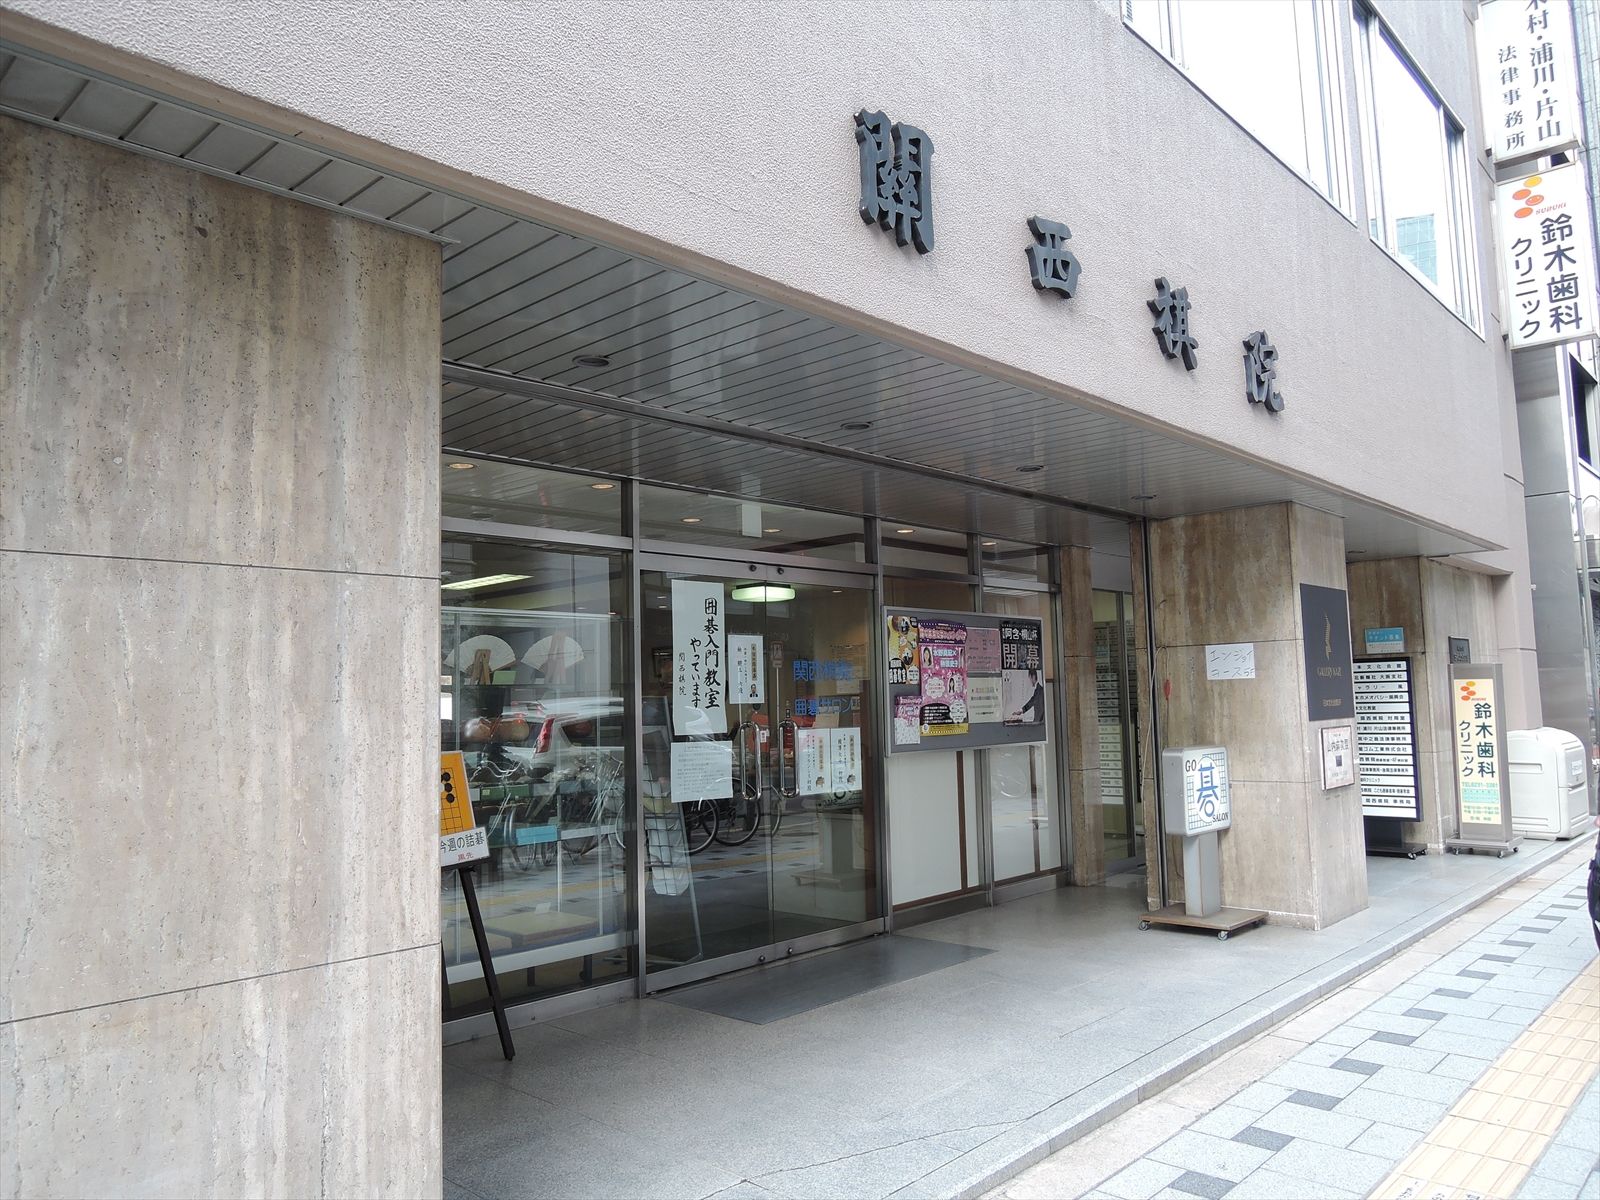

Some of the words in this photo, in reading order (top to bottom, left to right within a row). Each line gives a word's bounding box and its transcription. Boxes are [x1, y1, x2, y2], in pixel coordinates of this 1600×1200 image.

[1497, 45, 1526, 152] 法律事務所
[1510, 237, 1541, 339] クリニック
[1540, 213, 1583, 334] 鈴木歯科
[689, 637, 702, 708] やっています
[703, 597, 721, 709] 囲碁入門教室
[1003, 643, 1039, 669] 開幕
[1185, 759, 1197, 772] GO
[1459, 719, 1475, 777] クリニック
[1474, 702, 1496, 778] 鈴木歯科
[1196, 761, 1219, 818] 碁
[1212, 811, 1229, 823] SALON
